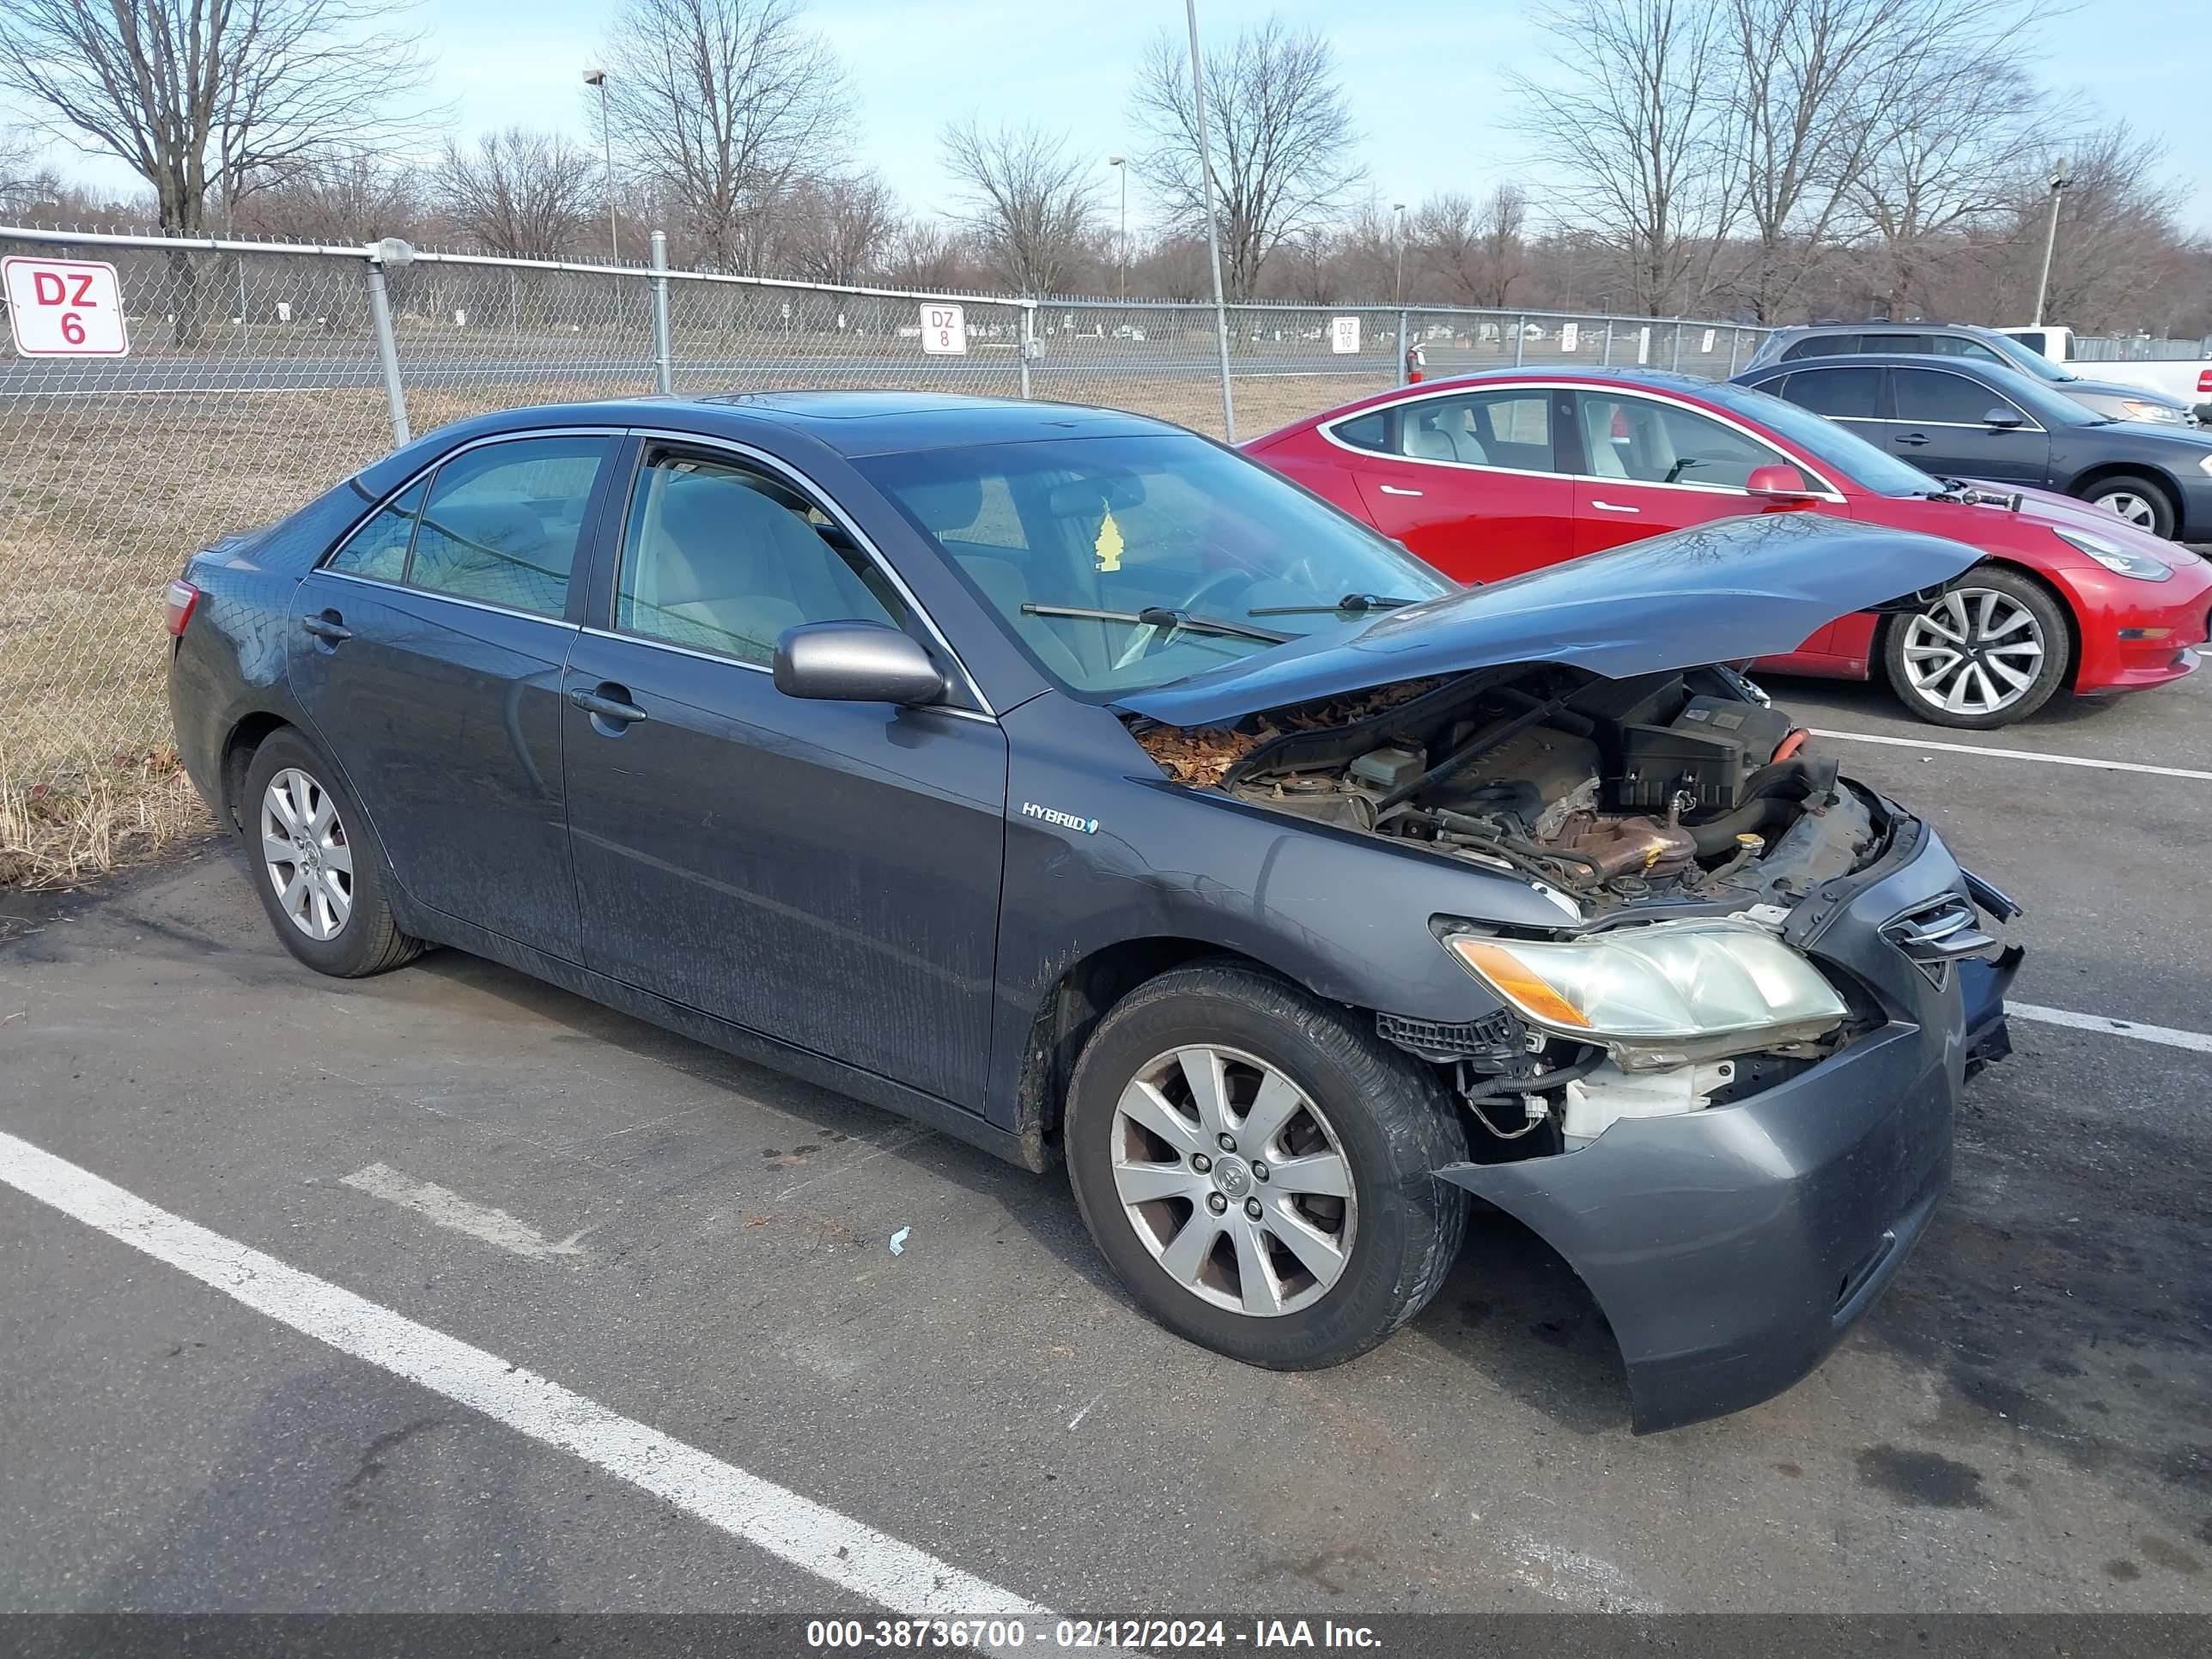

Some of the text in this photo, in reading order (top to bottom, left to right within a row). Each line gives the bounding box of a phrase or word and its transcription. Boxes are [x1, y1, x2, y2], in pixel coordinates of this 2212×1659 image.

[33, 271, 97, 307] DZ
[61, 312, 86, 344] 6
[932, 311, 954, 328] DZ
[1340, 322, 1353, 335] DZ
[940, 330, 949, 347] 8
[1341, 336, 1352, 348] 10
[1022, 802, 1086, 831] HYBRID
